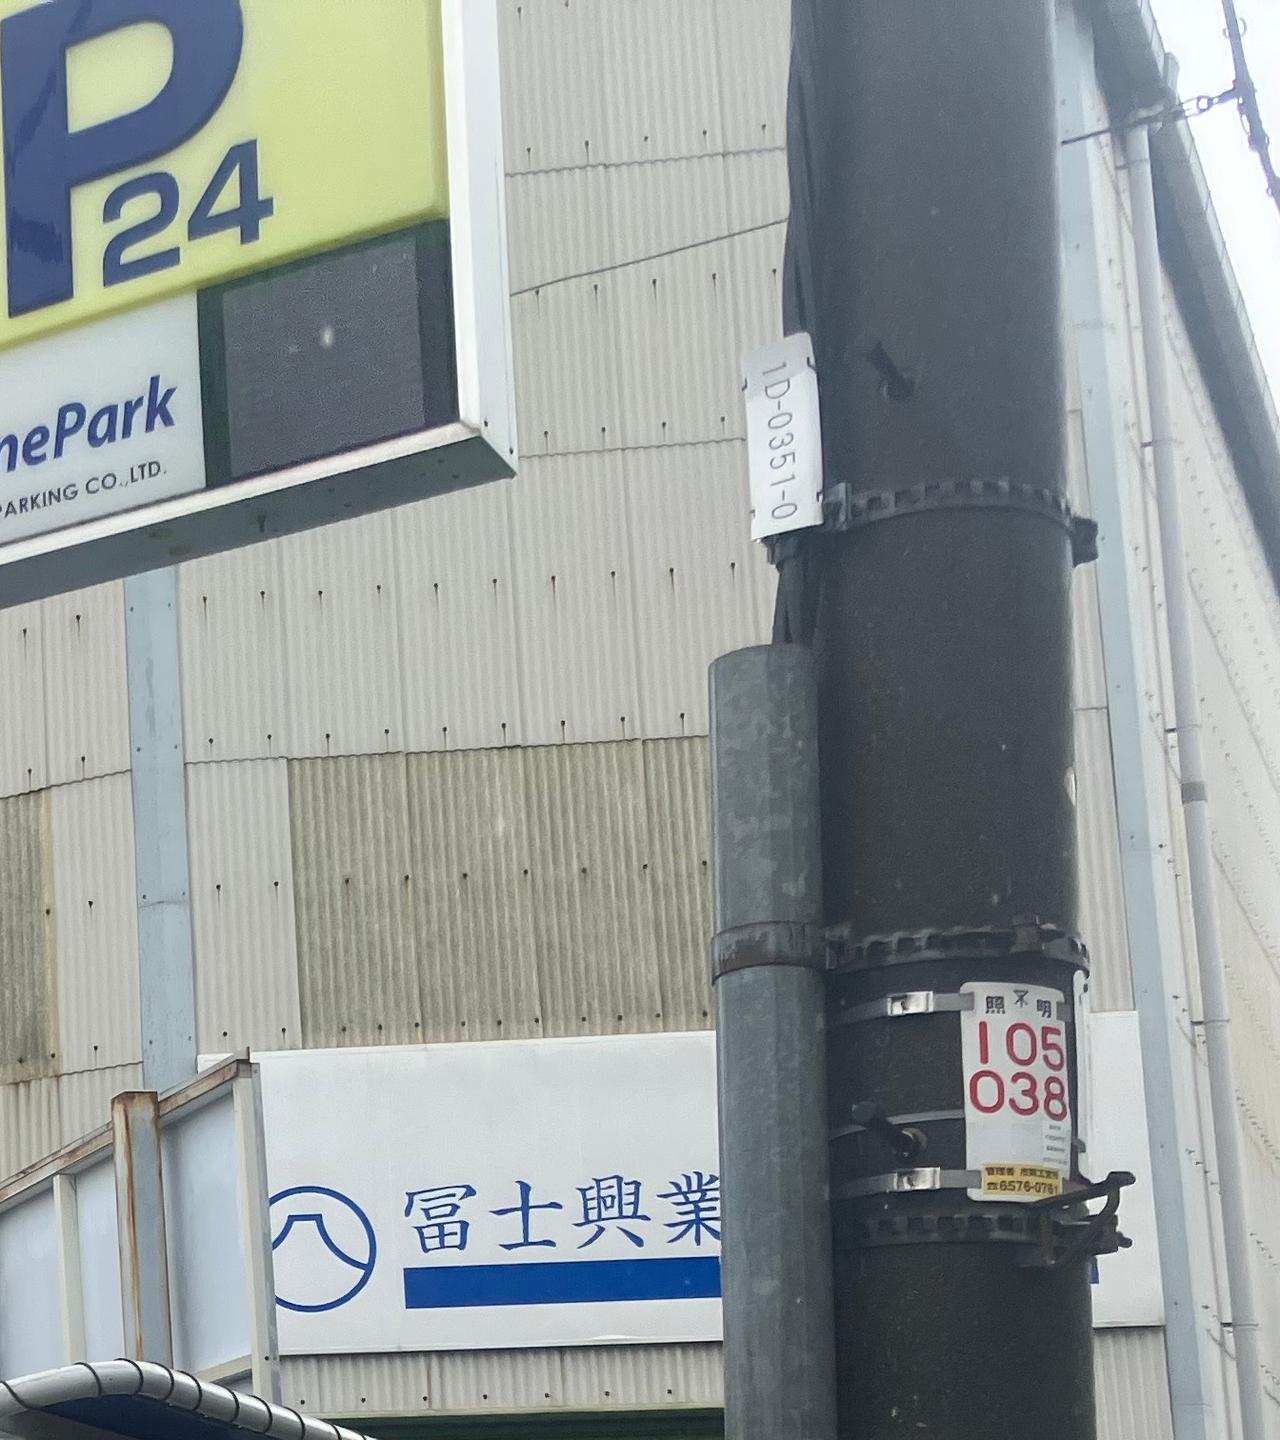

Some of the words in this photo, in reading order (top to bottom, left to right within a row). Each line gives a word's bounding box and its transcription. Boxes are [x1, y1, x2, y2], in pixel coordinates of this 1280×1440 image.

[0, 0, 243, 318] P
[102, 139, 274, 287] 24
[762, 361, 798, 520] 1D-0351-0
[969, 1070, 1068, 1122] 038
[979, 1021, 1065, 1072] 105
